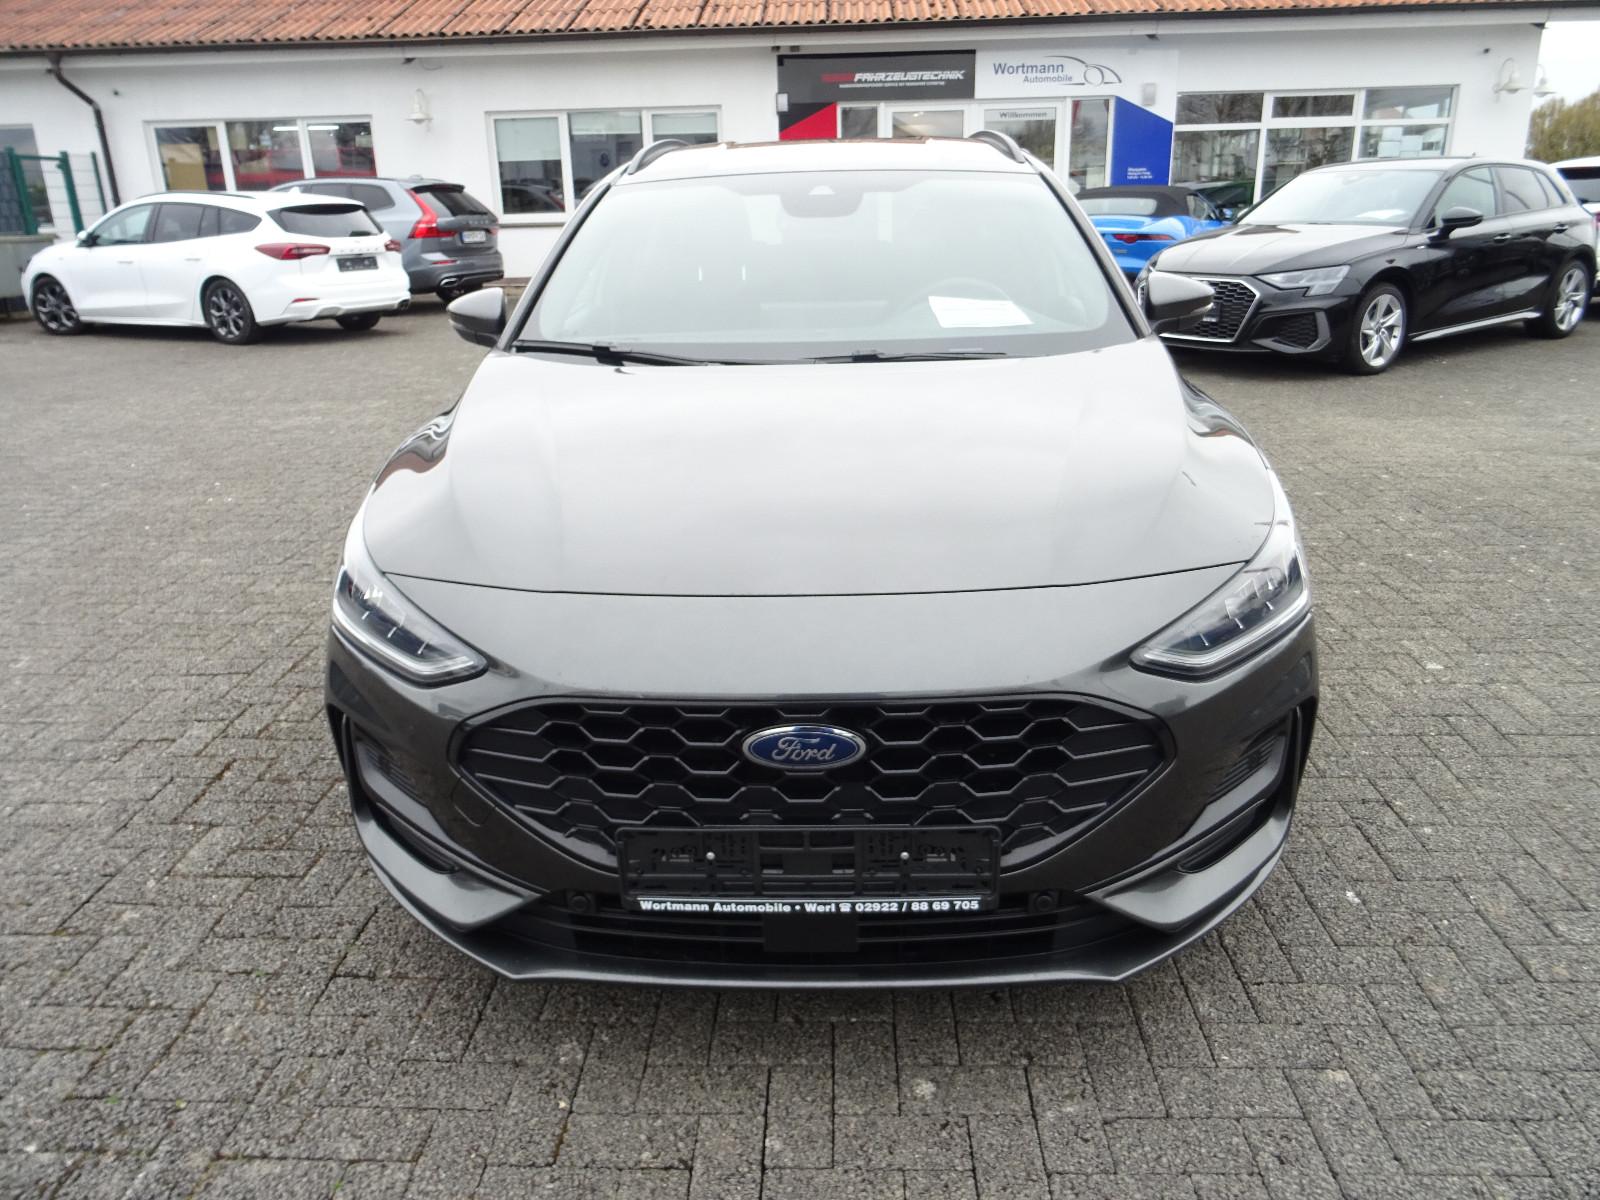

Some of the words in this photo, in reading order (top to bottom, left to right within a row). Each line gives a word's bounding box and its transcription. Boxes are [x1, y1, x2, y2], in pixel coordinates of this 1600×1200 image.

[993, 63, 1064, 75] Wortmann
[1023, 75, 1073, 83] Automobile
[1000, 111, 1047, 119] Willkommen
[771, 736, 837, 760] Ford
[639, 900, 709, 912] Wortmann
[713, 902, 791, 913] Automobile
[804, 902, 836, 912] Werl
[855, 902, 898, 912] 02922
[911, 901, 928, 911] 88
[932, 901, 950, 911] 69
[953, 900, 979, 910] 705
